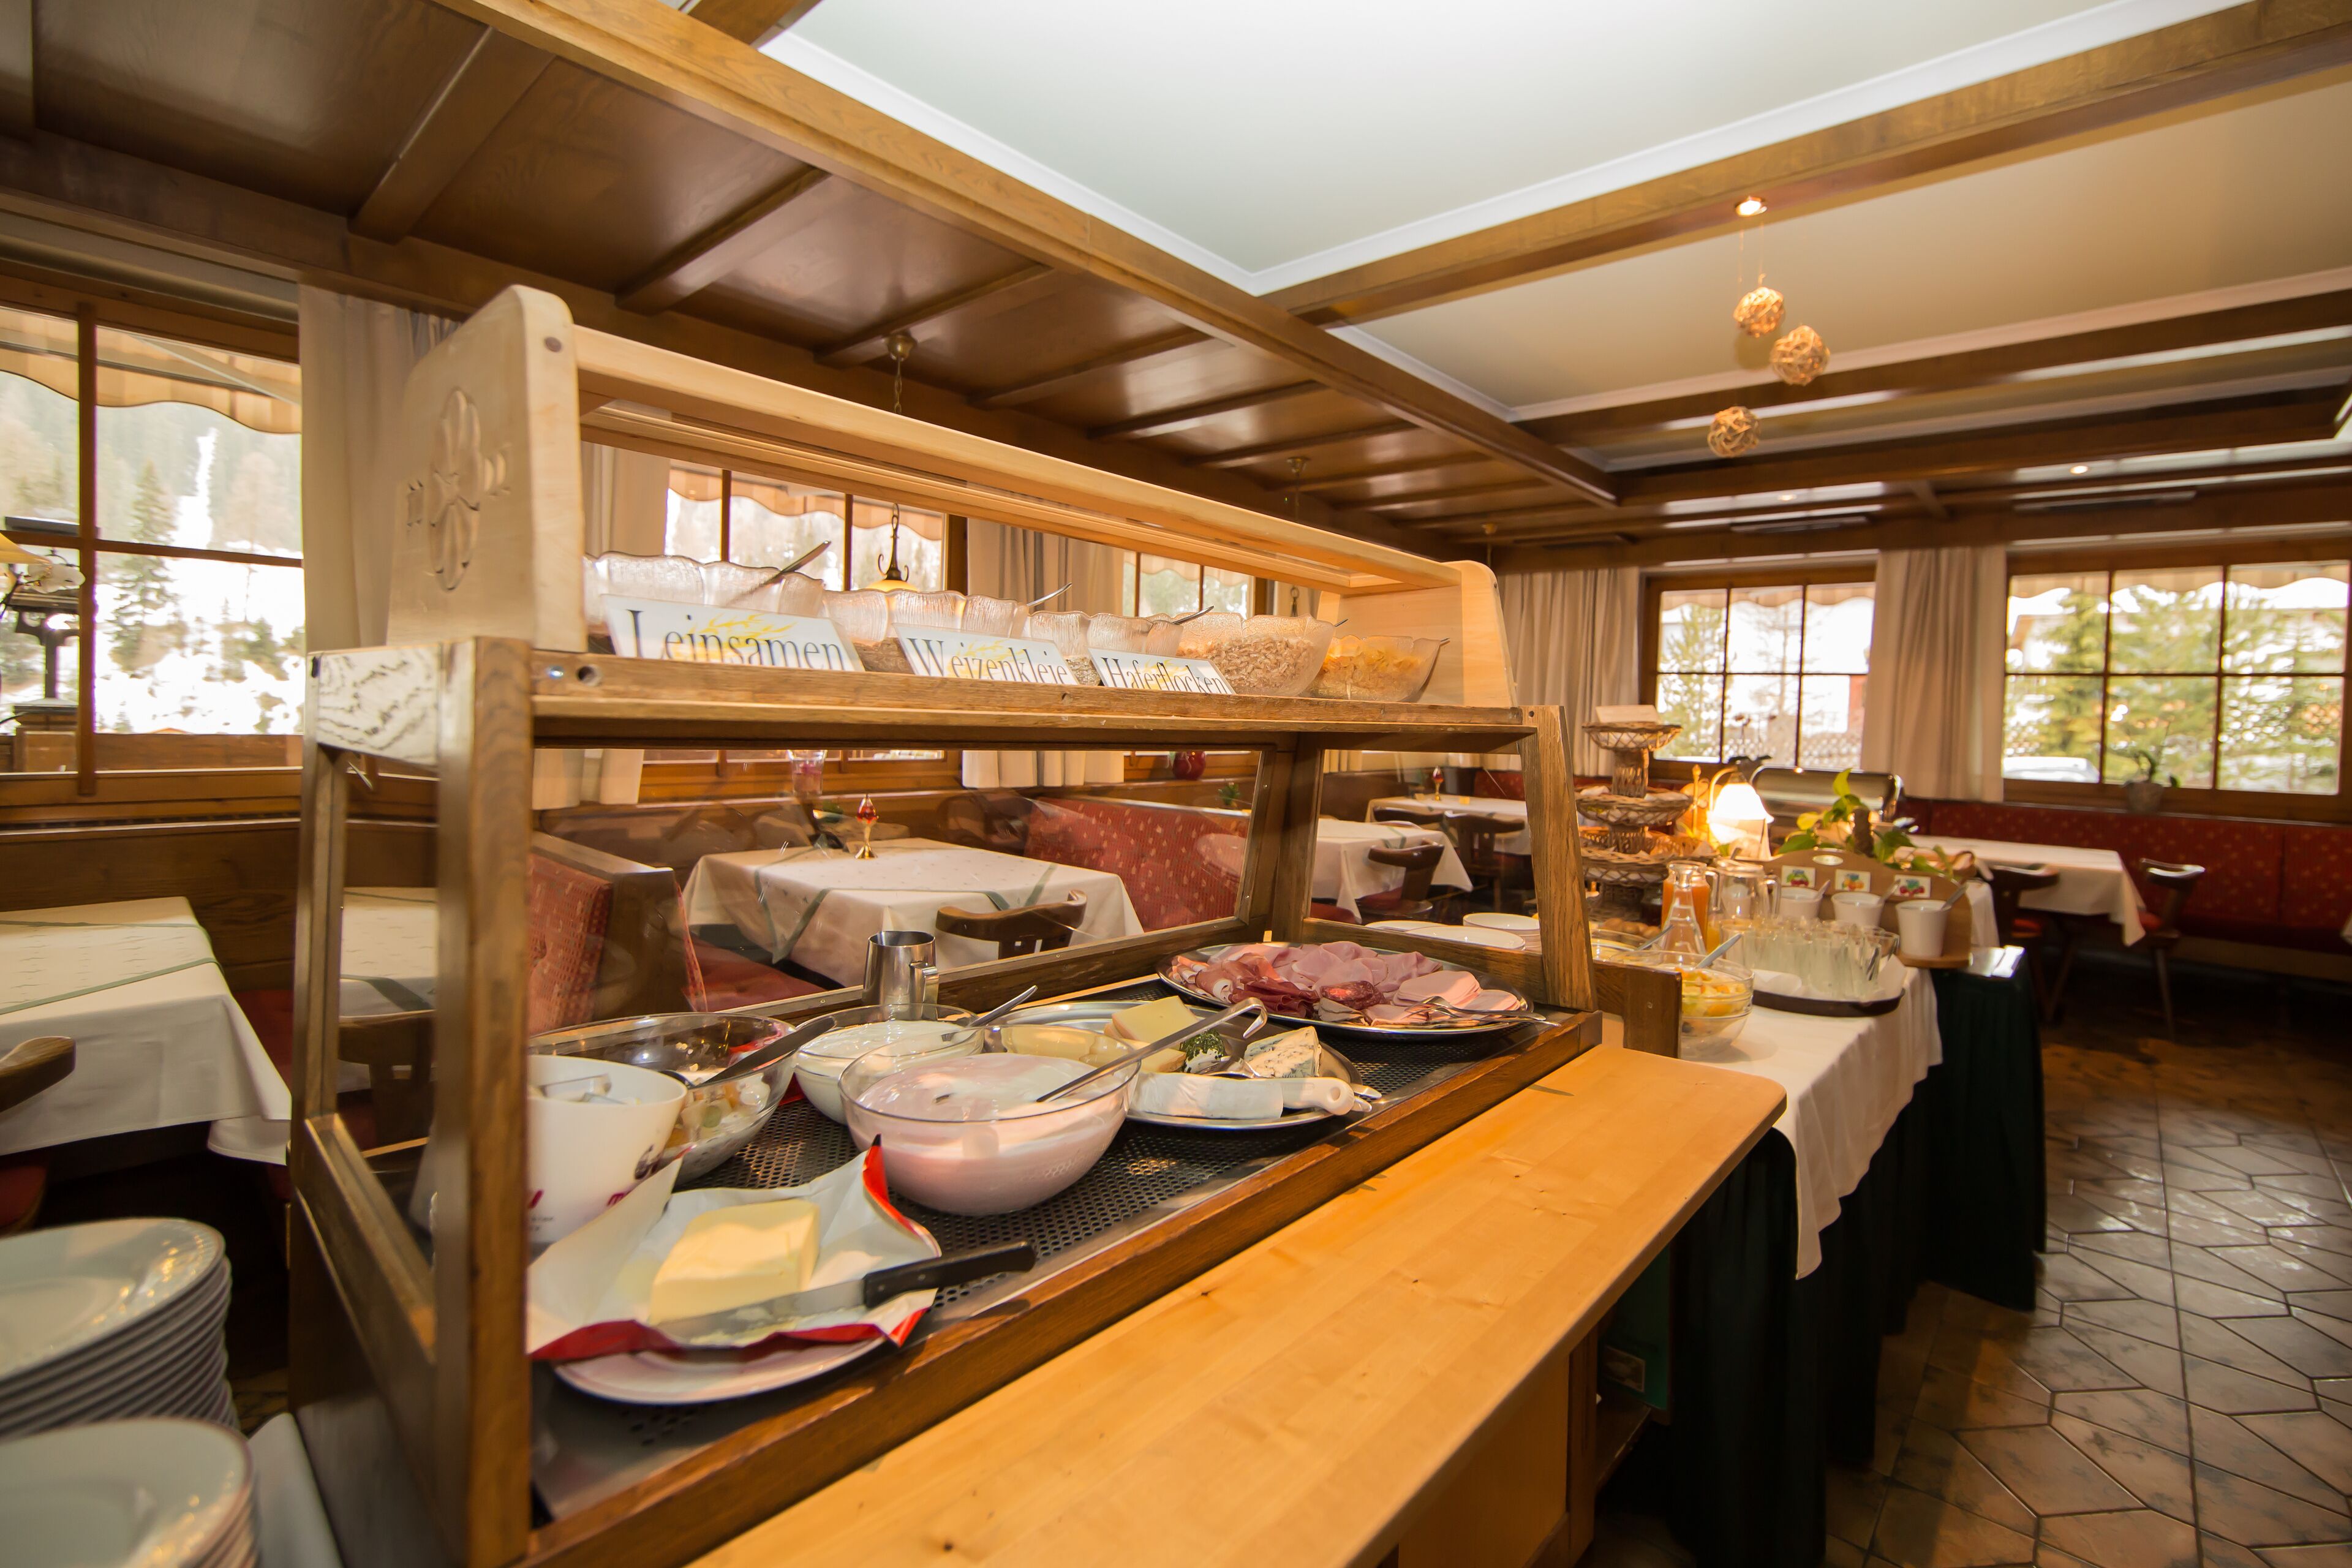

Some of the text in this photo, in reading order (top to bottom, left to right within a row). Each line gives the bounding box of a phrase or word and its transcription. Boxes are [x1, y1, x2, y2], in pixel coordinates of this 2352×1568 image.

[626, 609, 845, 671] Leinsamen
[907, 637, 1068, 685] Weizenkleie
[1101, 657, 1228, 694] Haferflocken
